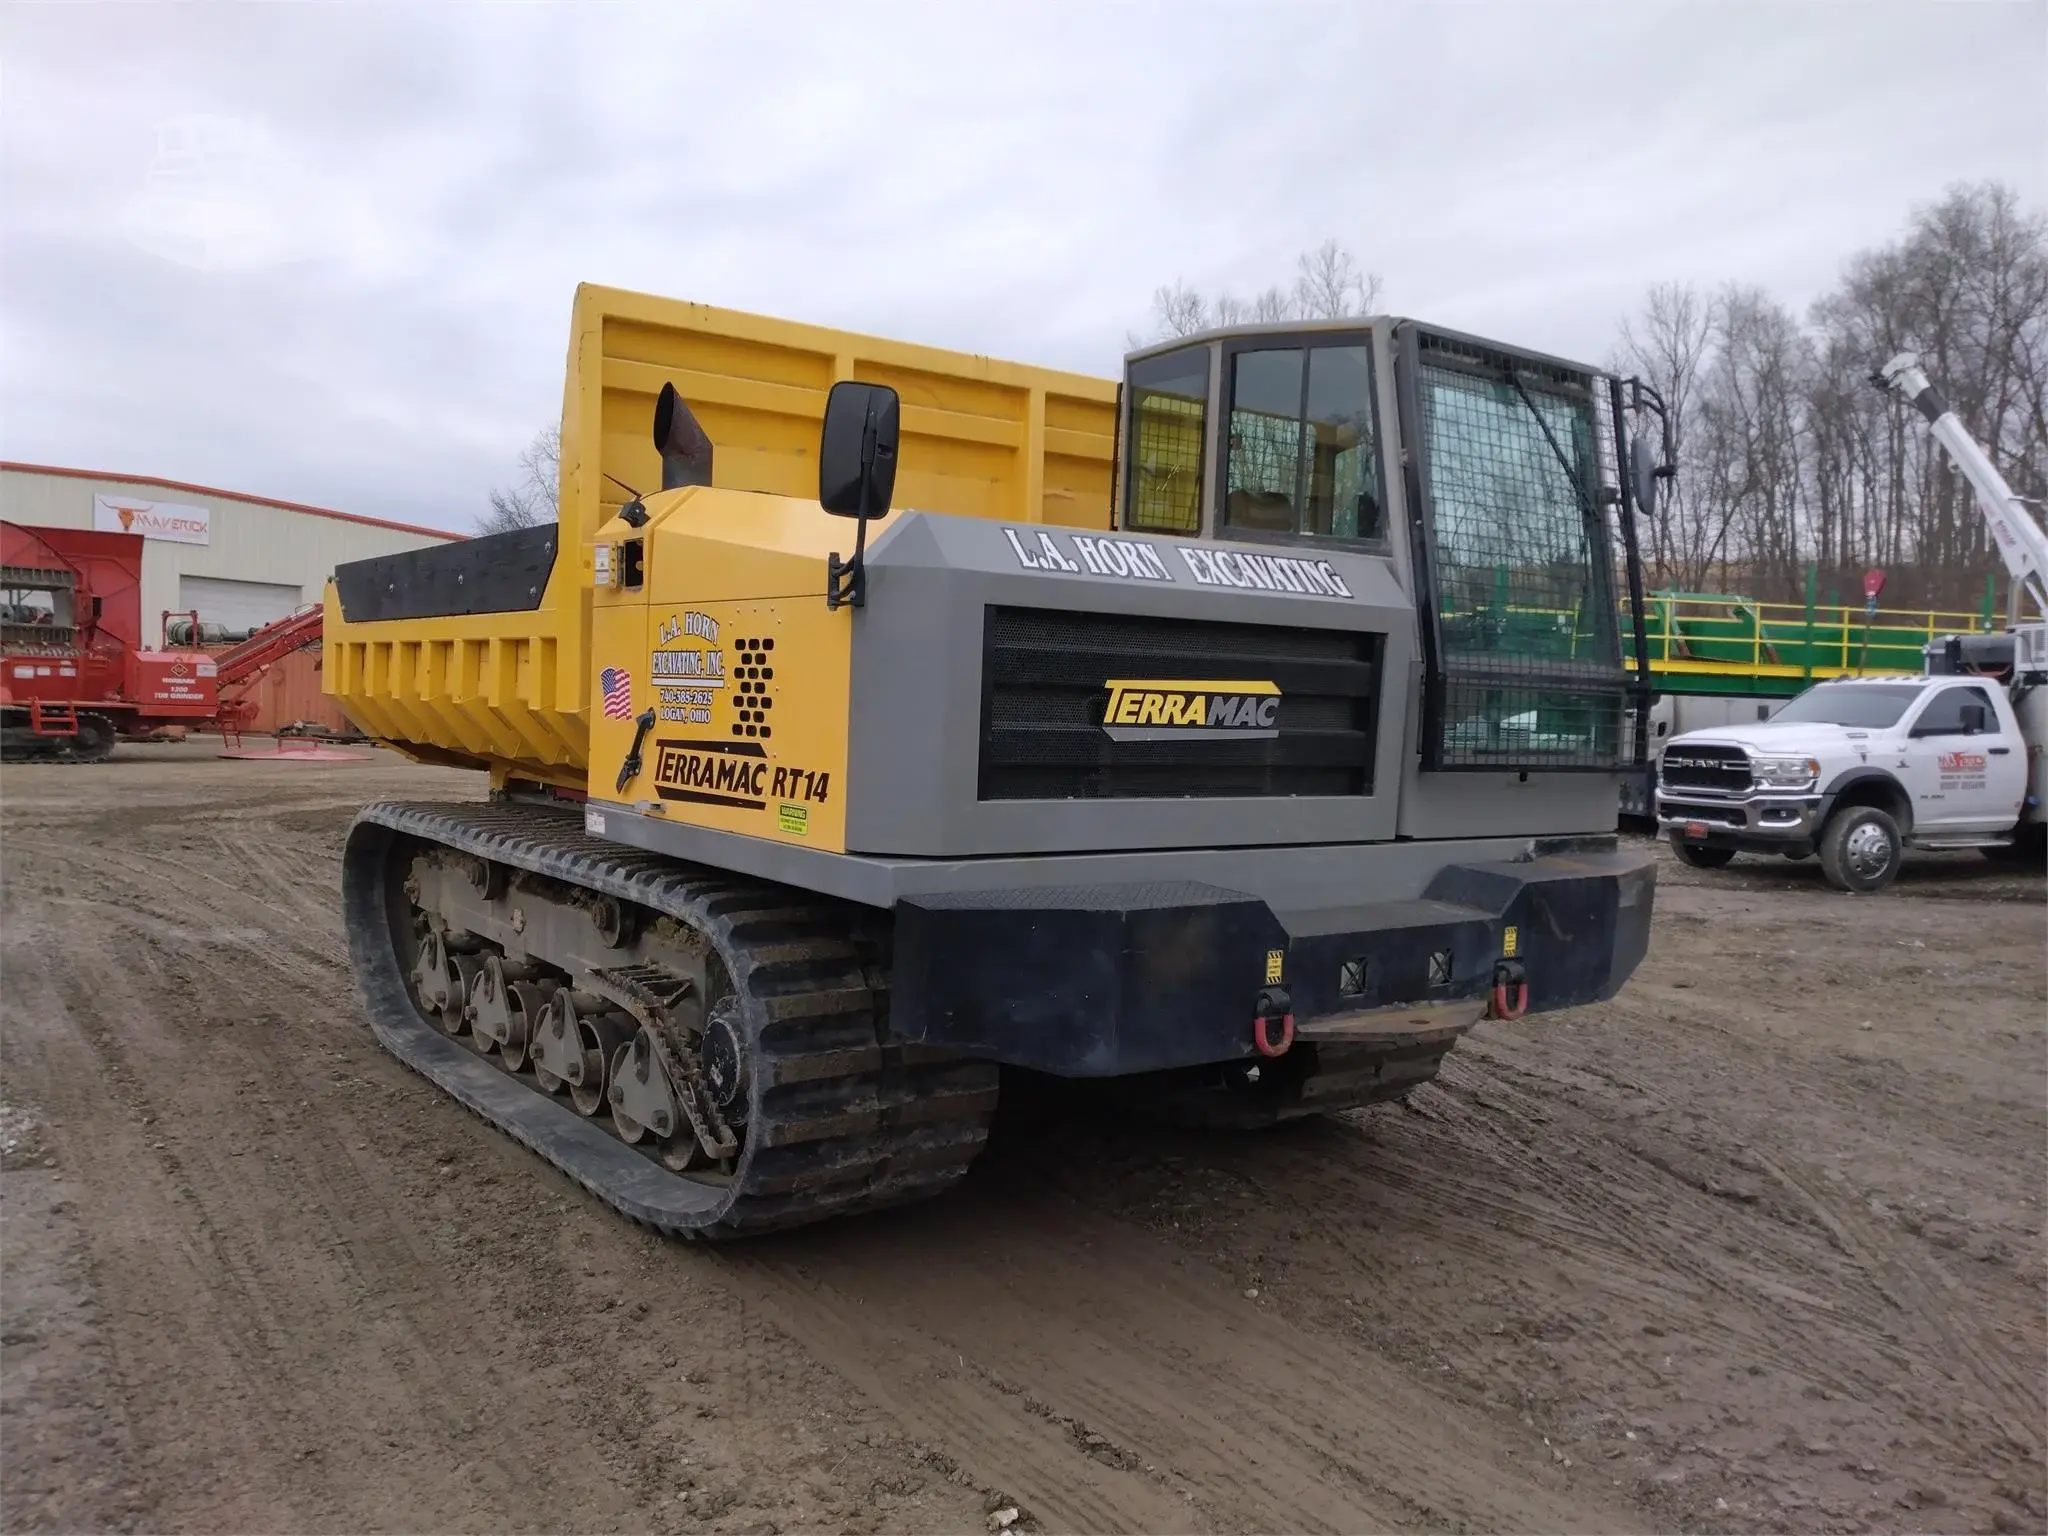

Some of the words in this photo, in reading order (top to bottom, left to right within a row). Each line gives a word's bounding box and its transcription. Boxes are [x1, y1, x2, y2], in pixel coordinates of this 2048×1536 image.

[137, 513, 208, 533] MAVERICK
[1002, 528, 1079, 572] L.A.
[1072, 535, 1175, 582] HORN
[1176, 546, 1353, 598] EXCAVATING
[660, 614, 682, 647] L.A.
[684, 610, 720, 647] HORN
[652, 650, 705, 678] EXCAVATING,
[706, 650, 725, 676] INC.
[660, 688, 714, 705] 740-385-2625
[1103, 679, 1280, 729] TERRAMAC
[660, 706, 689, 723] LOGAN,
[690, 708, 711, 723] OHIO
[655, 739, 768, 796] TERRAMAC
[771, 766, 830, 803] RT14
[1682, 759, 1720, 769] RAM
